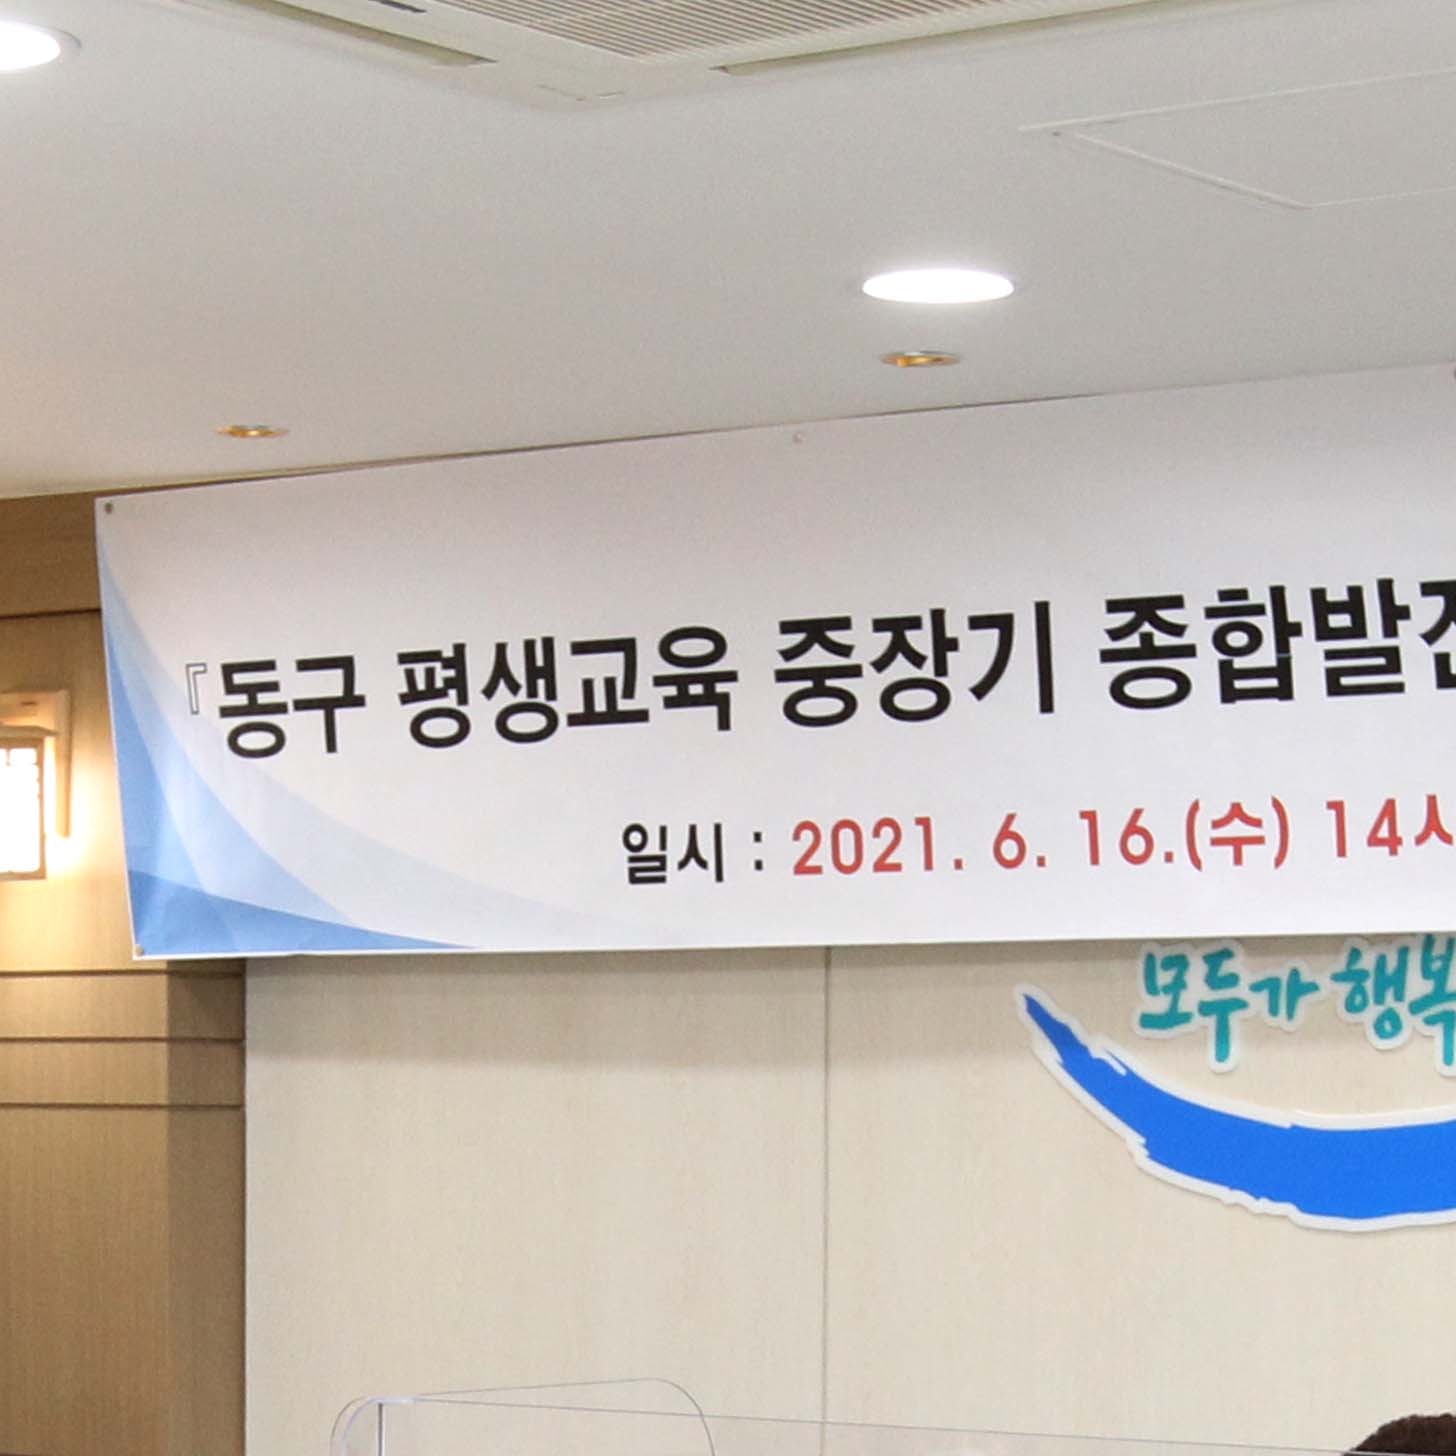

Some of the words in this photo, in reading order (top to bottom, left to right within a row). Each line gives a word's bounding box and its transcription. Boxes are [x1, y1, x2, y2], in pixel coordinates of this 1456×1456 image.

[396, 625, 740, 750] 평생교육
[772, 599, 1056, 729] 중장기
[792, 815, 964, 876] 2021.
[992, 813, 1046, 870] 6.
[1139, 948, 1320, 1063] 모두가
